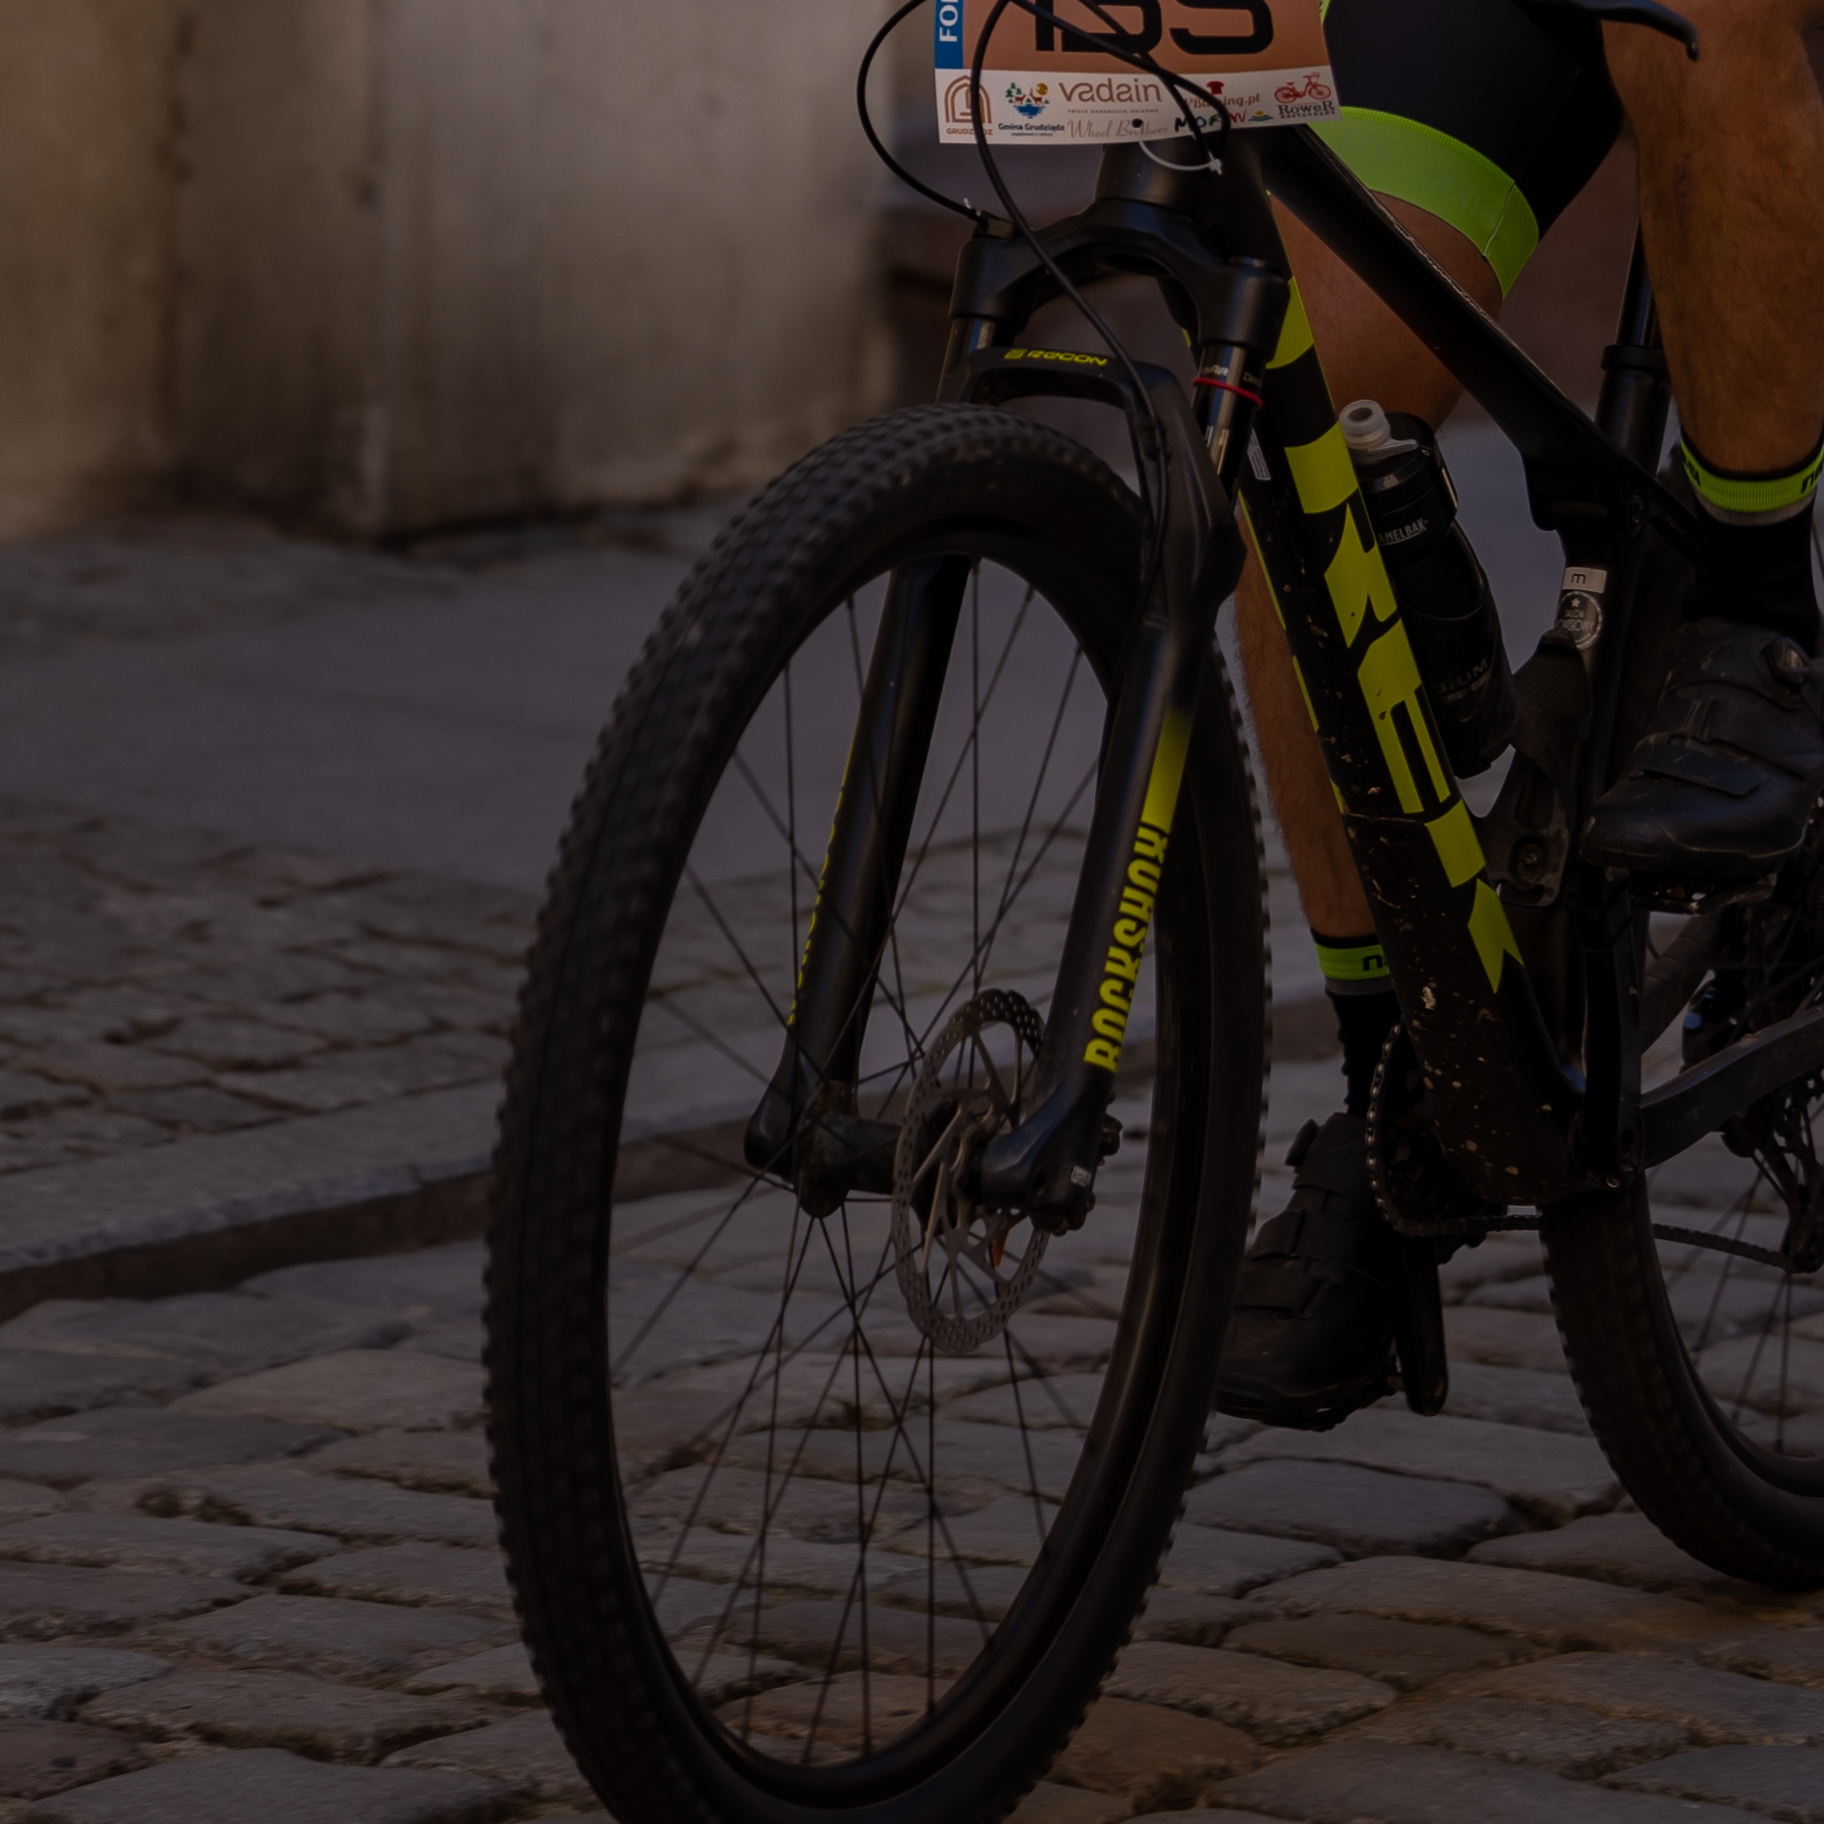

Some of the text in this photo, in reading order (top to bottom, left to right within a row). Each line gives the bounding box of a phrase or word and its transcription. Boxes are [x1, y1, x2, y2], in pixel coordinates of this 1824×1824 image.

[1058, 77, 1163, 103] vadain
[945, 127, 994, 136] GRUDZDZ
[1377, 517, 1427, 544] AMELBAK
